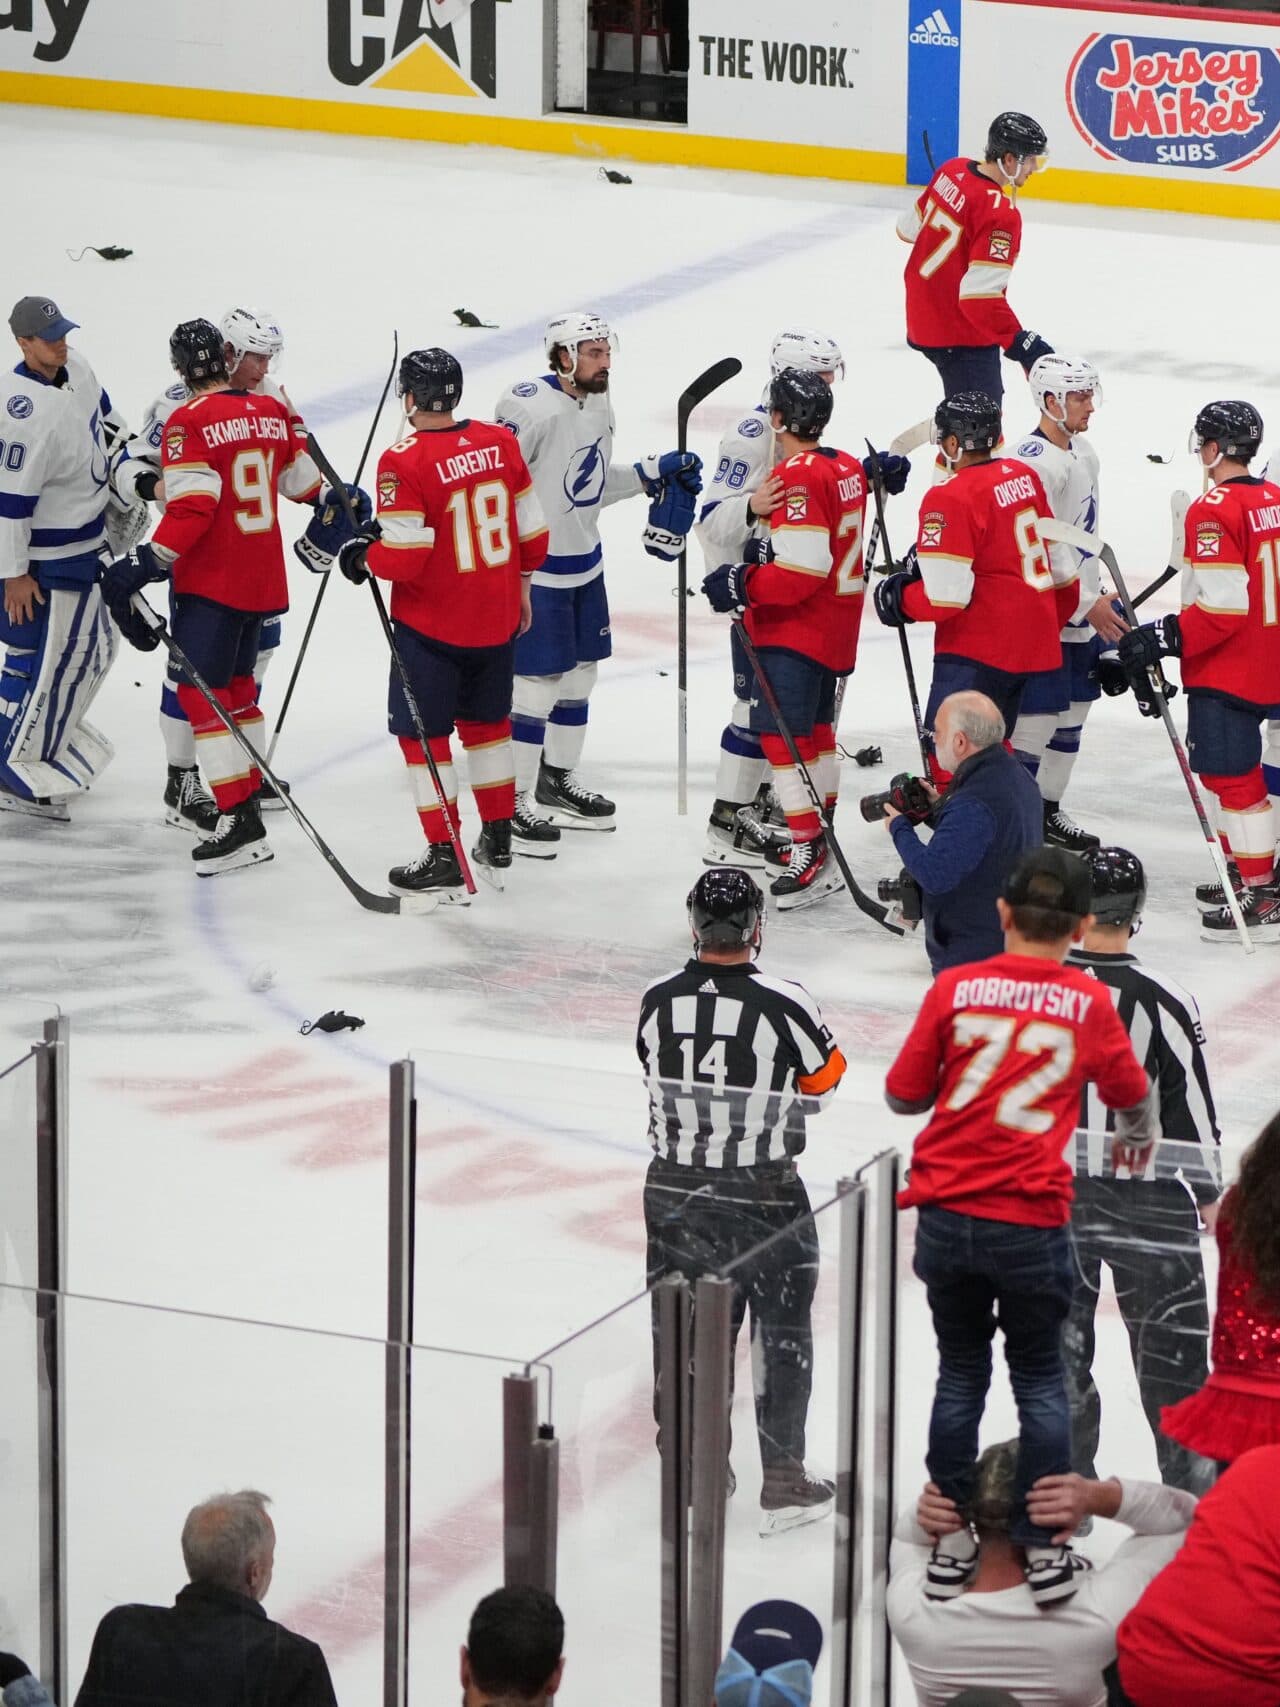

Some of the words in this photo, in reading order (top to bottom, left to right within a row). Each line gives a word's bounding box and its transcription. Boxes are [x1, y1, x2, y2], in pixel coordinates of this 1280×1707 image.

[910, 32, 959, 48] adidas
[699, 35, 753, 79] THE
[761, 41, 854, 88] WORK.
[1099, 42, 1260, 94] Jersey
[1113, 87, 1260, 137] Mike's
[1156, 143, 1216, 162] SUBS
[198, 349, 210, 361] 91
[445, 384, 454, 395] 18
[1249, 426, 1258, 436] 15
[0, 438, 28, 472] 0
[436, 446, 504, 485] LORENTZ
[993, 475, 1037, 509] OKPOSO
[445, 479, 513, 574] 18
[643, 529, 683, 547] CCM
[300, 538, 333, 566] CCM
[1015, 506, 1056, 593] 8
[17, 692, 47, 758] TRUE
[953, 976, 1093, 1025] BOBROVSKY
[679, 1039, 728, 1096] 14
[946, 1013, 1077, 1135] 72
